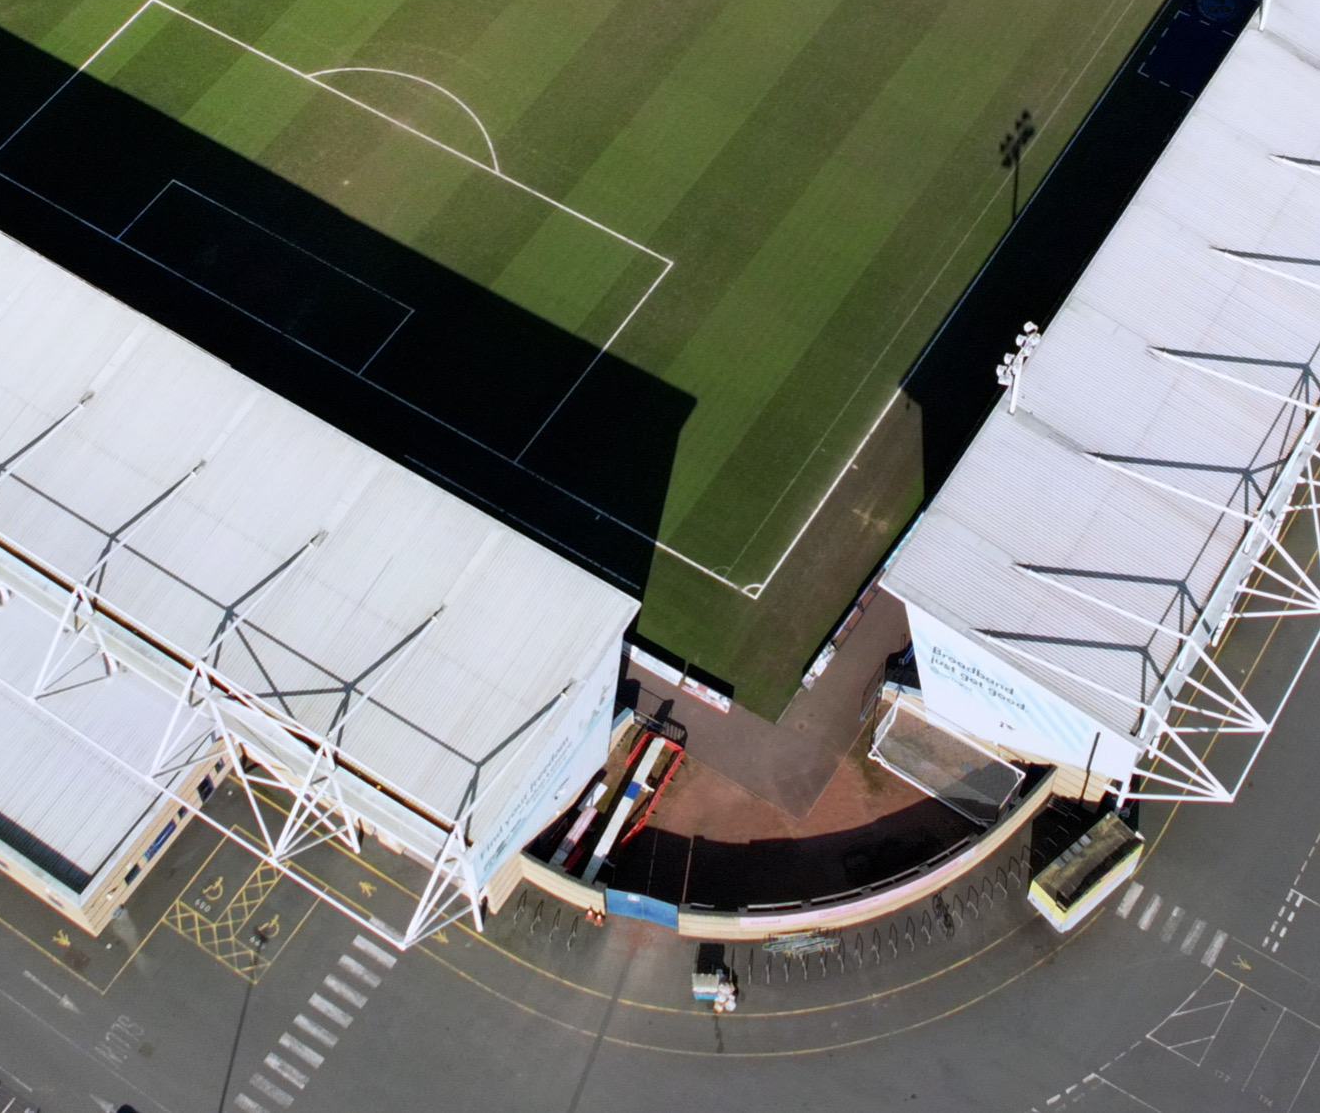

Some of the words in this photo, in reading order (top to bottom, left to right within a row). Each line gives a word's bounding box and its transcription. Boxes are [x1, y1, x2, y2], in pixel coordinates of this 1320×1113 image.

[930, 655, 956, 675] just
[960, 668, 984, 688] got
[932, 647, 1015, 696] Broadband
